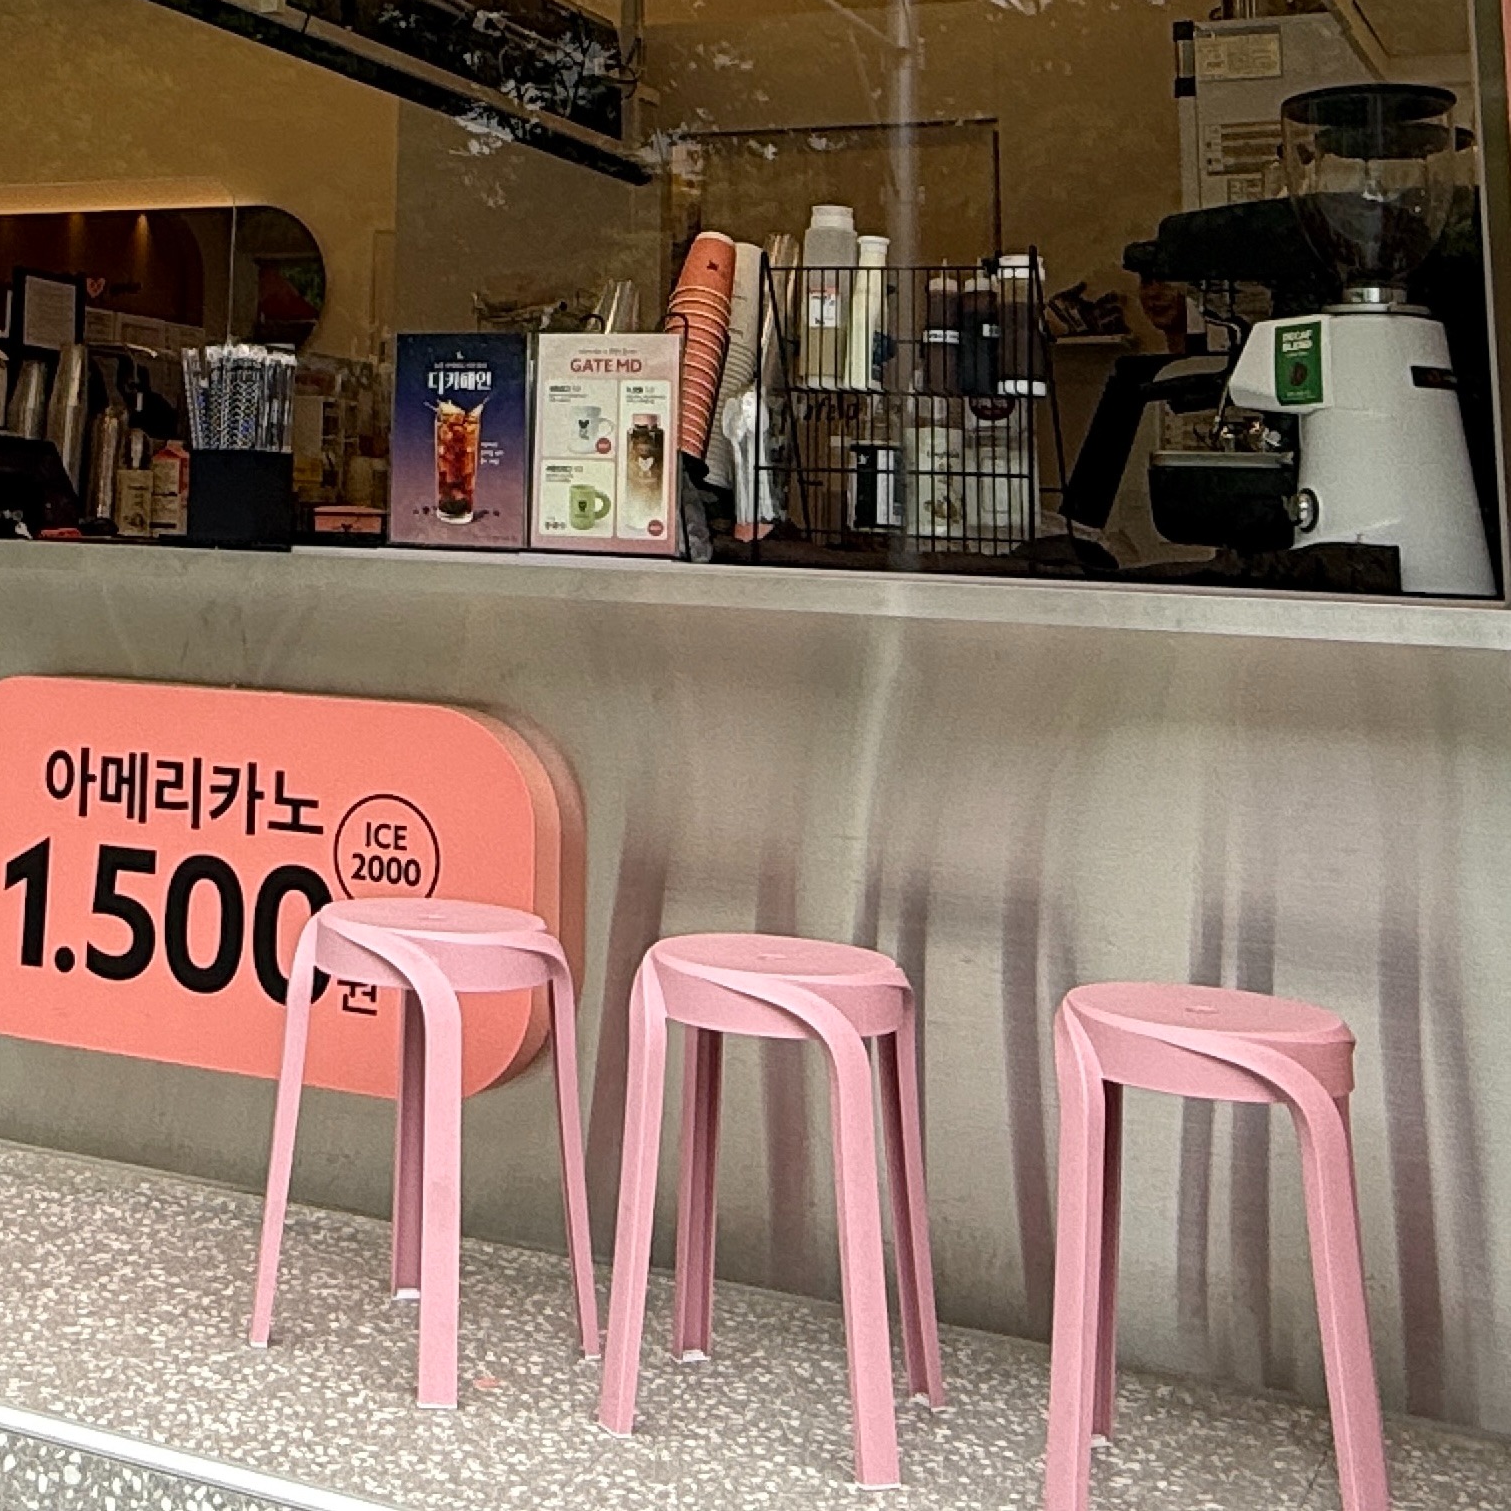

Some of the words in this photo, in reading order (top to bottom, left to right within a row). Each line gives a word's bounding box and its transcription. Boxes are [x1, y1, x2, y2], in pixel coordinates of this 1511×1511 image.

[571, 359, 616, 373] GATE
[616, 359, 642, 373] MD
[45, 746, 324, 836] 아메리카노
[364, 821, 408, 852] ICE
[351, 852, 421, 887] 2000
[4, 836, 333, 1007] 1.500
